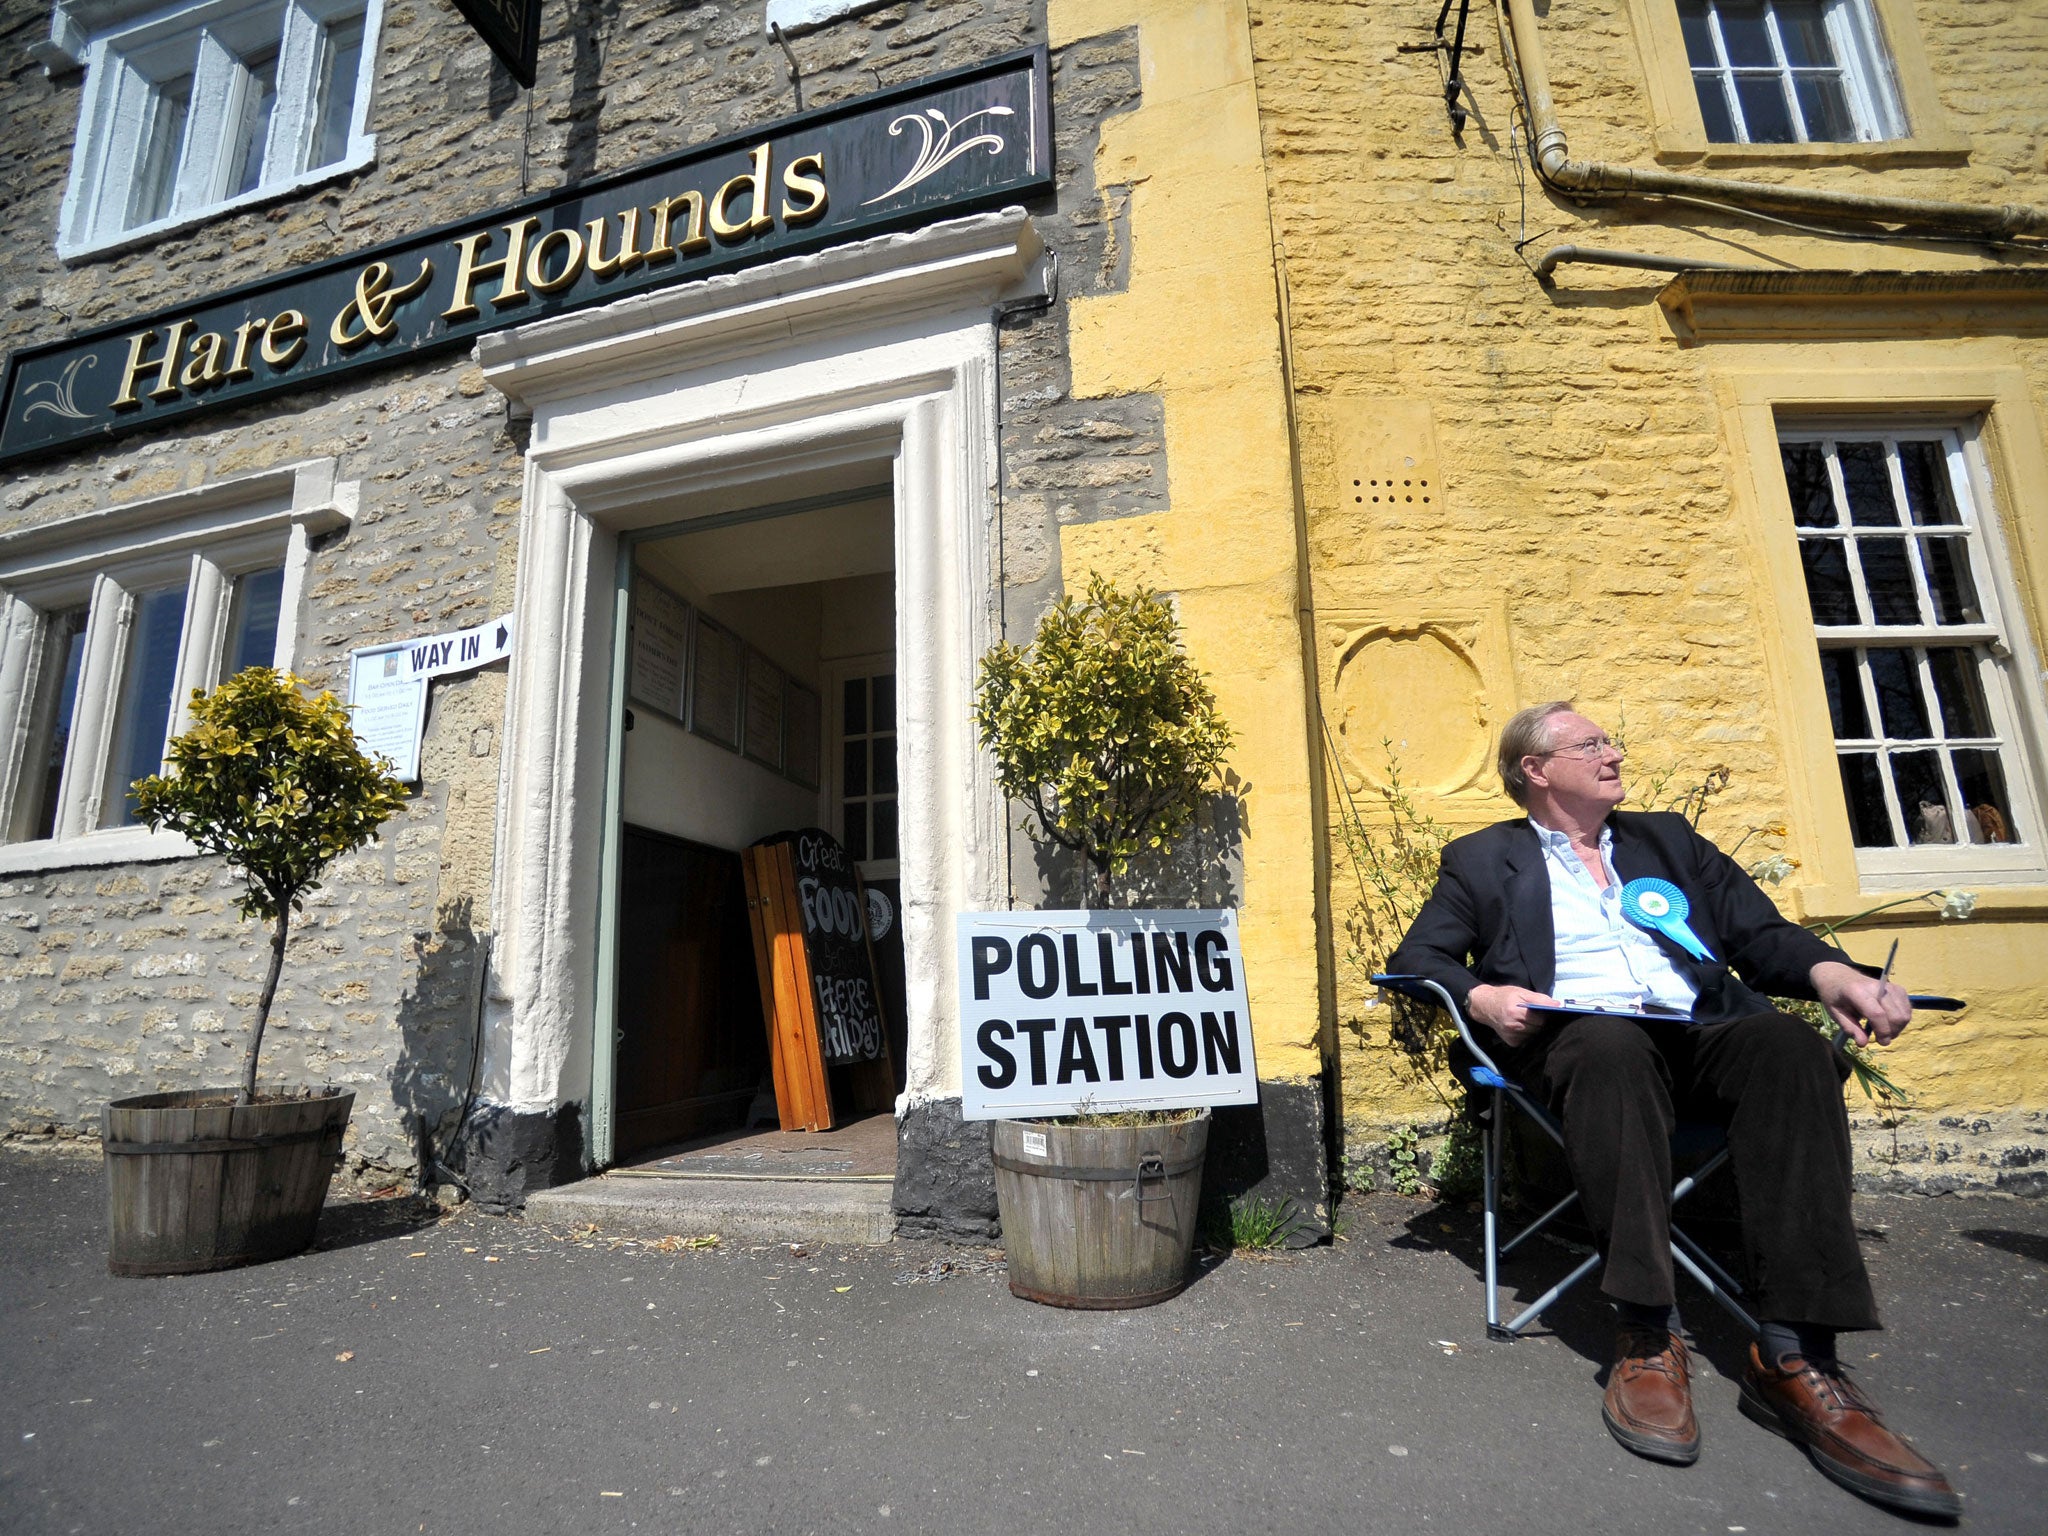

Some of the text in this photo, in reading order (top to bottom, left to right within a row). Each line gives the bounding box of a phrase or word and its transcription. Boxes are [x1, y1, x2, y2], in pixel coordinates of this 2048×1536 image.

[108, 142, 829, 411] Hare & Hounds
[411, 634, 480, 672] WAY IN
[799, 835, 845, 873] Great
[798, 877, 863, 943] FOOD
[971, 929, 1235, 1001] POLLING
[823, 1013, 880, 1060] All Day
[976, 1010, 1243, 1090] STATION
